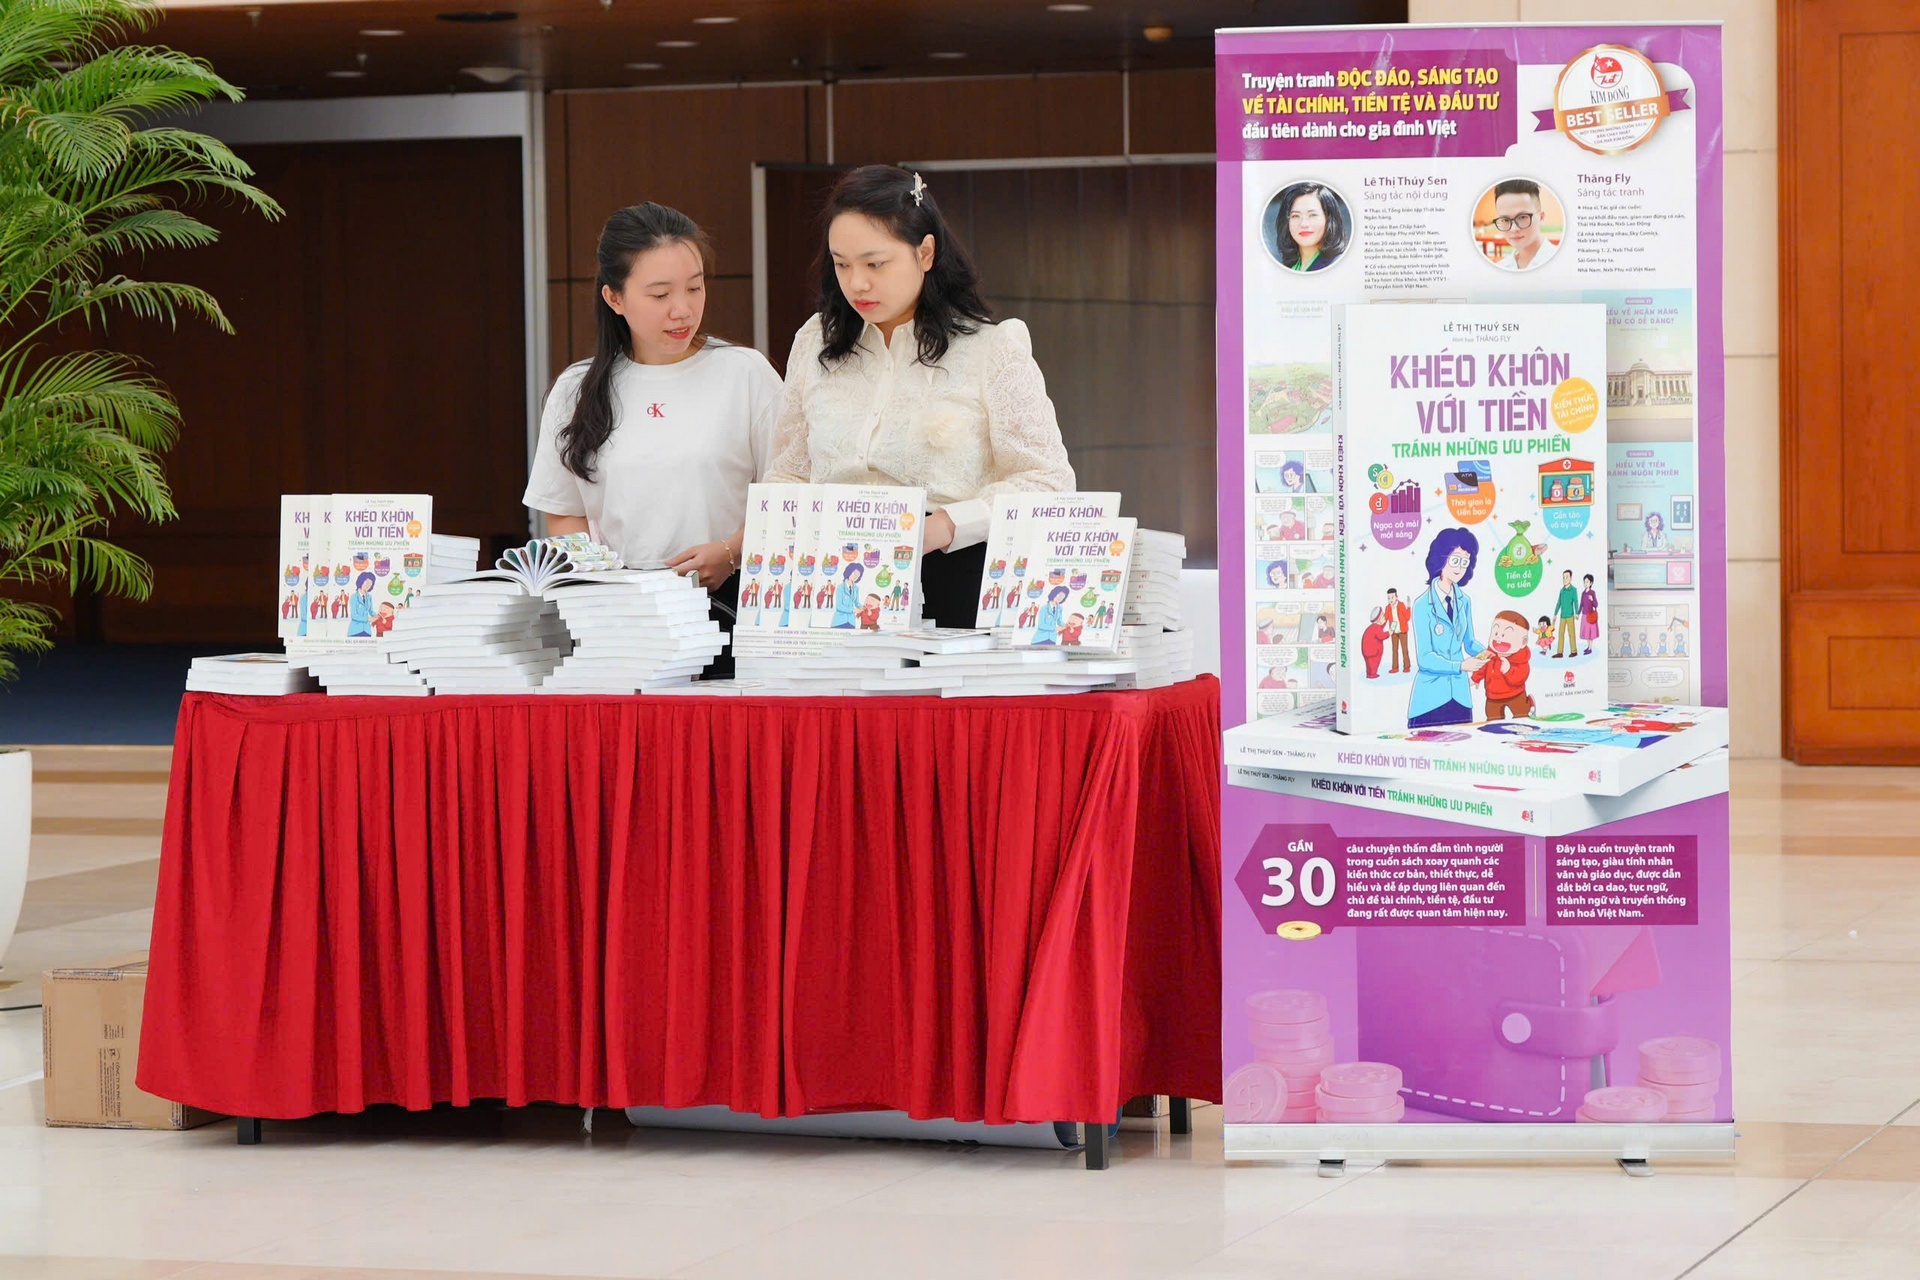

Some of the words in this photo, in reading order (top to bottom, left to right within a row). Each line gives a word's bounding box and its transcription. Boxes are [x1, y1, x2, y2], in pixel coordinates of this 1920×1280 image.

[1242, 73, 1293, 93] Truyện
[1296, 72, 1335, 88] tranh
[1337, 69, 1372, 90] ĐỘC
[1375, 67, 1415, 88] ĐÁO,
[1418, 66, 1462, 86] SÁNG
[1465, 68, 1499, 88] TẠO
[1242, 94, 1264, 115] VỀ
[1267, 94, 1293, 114] TÀI
[1295, 93, 1349, 115] CHÍNH,
[1352, 91, 1388, 112] TIỀN
[1391, 93, 1410, 115] TỆ
[1413, 91, 1437, 111] VÀ
[1439, 89, 1474, 111] ĐẦU
[1477, 91, 1500, 110] TƯ
[1590, 89, 1607, 104] KIM
[1566, 111, 1602, 128] BEST
[1606, 102, 1659, 121] SELLER
[1242, 121, 1270, 139] đầu
[1272, 121, 1299, 139] tiên
[1302, 121, 1337, 138] dành
[1339, 121, 1366, 138] cho
[1368, 121, 1391, 141] gia
[1393, 120, 1424, 136] đình
[1427, 119, 1457, 139] Việt
[1364, 177, 1376, 186] Lê
[1379, 177, 1395, 188] Thị
[1398, 176, 1424, 187] Thúy
[1428, 176, 1447, 185] Sen
[1578, 174, 1612, 185] Thăng
[1615, 174, 1631, 185] Fly
[1364, 191, 1387, 201] Sáng
[1390, 191, 1403, 199] tác
[1406, 190, 1420, 199] nội
[1423, 190, 1448, 200] dung
[1578, 188, 1600, 199] Sáng
[1603, 188, 1617, 197] tác
[1620, 188, 1644, 196] tranh
[1443, 321, 1454, 332] LÊ
[1457, 324, 1472, 334] THỊ
[1475, 322, 1499, 332] THUÝ
[1502, 323, 1520, 332] SEN
[1390, 348, 1476, 388] KHÉO
[1488, 346, 1570, 387] KHÔN
[1416, 394, 1466, 434] VỚI
[1478, 390, 1547, 432] TIỀN
[1392, 438, 1441, 458] TRÁNH
[1446, 437, 1498, 455] NHỮNG
[1503, 439, 1523, 454] ƯU
[1527, 434, 1571, 453] PHIỀN
[837, 499, 870, 513] KHÉO
[874, 500, 907, 515] KHÔN
[1468, 498, 1483, 507] gian
[1485, 497, 1492, 505] là
[345, 508, 377, 522] KHÉO
[381, 508, 414, 522] KHÔN
[1032, 505, 1065, 518] KHÉO
[1069, 505, 1103, 518] KHÔN
[846, 515, 864, 529] VỚI
[870, 515, 896, 530] TIỀN
[1373, 522, 1392, 531] Ngọc
[355, 524, 373, 538] VỚI
[377, 524, 404, 538] TIỀN
[1047, 529, 1081, 542] KHÉO
[1085, 530, 1119, 542] KHÔN
[1395, 531, 1413, 539] sáng
[1055, 543, 1074, 556] VỚI
[1079, 543, 1106, 556] TIỀN
[1338, 751, 1362, 764] KHÉO
[1365, 753, 1389, 766] KHÔN
[1392, 756, 1407, 768] VỚI
[1433, 758, 1466, 772] TRÁNH
[1469, 761, 1504, 775] NHỮNG
[1508, 764, 1522, 776] ƯU
[1525, 765, 1556, 779] PHIỀN
[1311, 777, 1331, 790] KHÉO
[1387, 789, 1415, 804] TRÁNH
[1417, 794, 1447, 809] NHỮNG
[1450, 799, 1462, 811] ƯU
[1465, 801, 1493, 816] PHIỀN
[1288, 839, 1314, 852] GẦN
[1347, 845, 1363, 853] câu
[1365, 844, 1400, 856] chuyện
[1402, 843, 1428, 853] thấm
[1430, 843, 1451, 853] đẫm
[1453, 844, 1473, 853] tình
[1475, 844, 1504, 854] người
[1556, 844, 1575, 855] Đây
[1578, 844, 1586, 853] là
[1589, 843, 1612, 853] cuốn
[1614, 844, 1646, 856] truyện
[1649, 844, 1675, 853] tranh
[1347, 858, 1374, 868] trong
[1376, 857, 1399, 866] cuốn
[1402, 857, 1423, 866] sách
[1425, 858, 1449, 867] xoay
[1450, 857, 1481, 867] quanh
[1484, 857, 1499, 865] các
[1261, 856, 1337, 907] 30
[1557, 896, 1586, 905] thành
[1588, 896, 1608, 907] ngữ
[1609, 896, 1620, 904] và
[1622, 894, 1655, 906] truyền
[1656, 895, 1686, 906] thống
[1347, 908, 1372, 919] đang
[1374, 907, 1388, 917] rất
[1390, 908, 1414, 919] được
[1416, 909, 1441, 919] quan
[1442, 908, 1462, 917] tâm
[1464, 908, 1485, 918] hiện
[1487, 910, 1508, 918] nay.
[1577, 909, 1596, 917] hoá
[1597, 909, 1617, 919] Việt
[1618, 909, 1644, 917] Nam.
